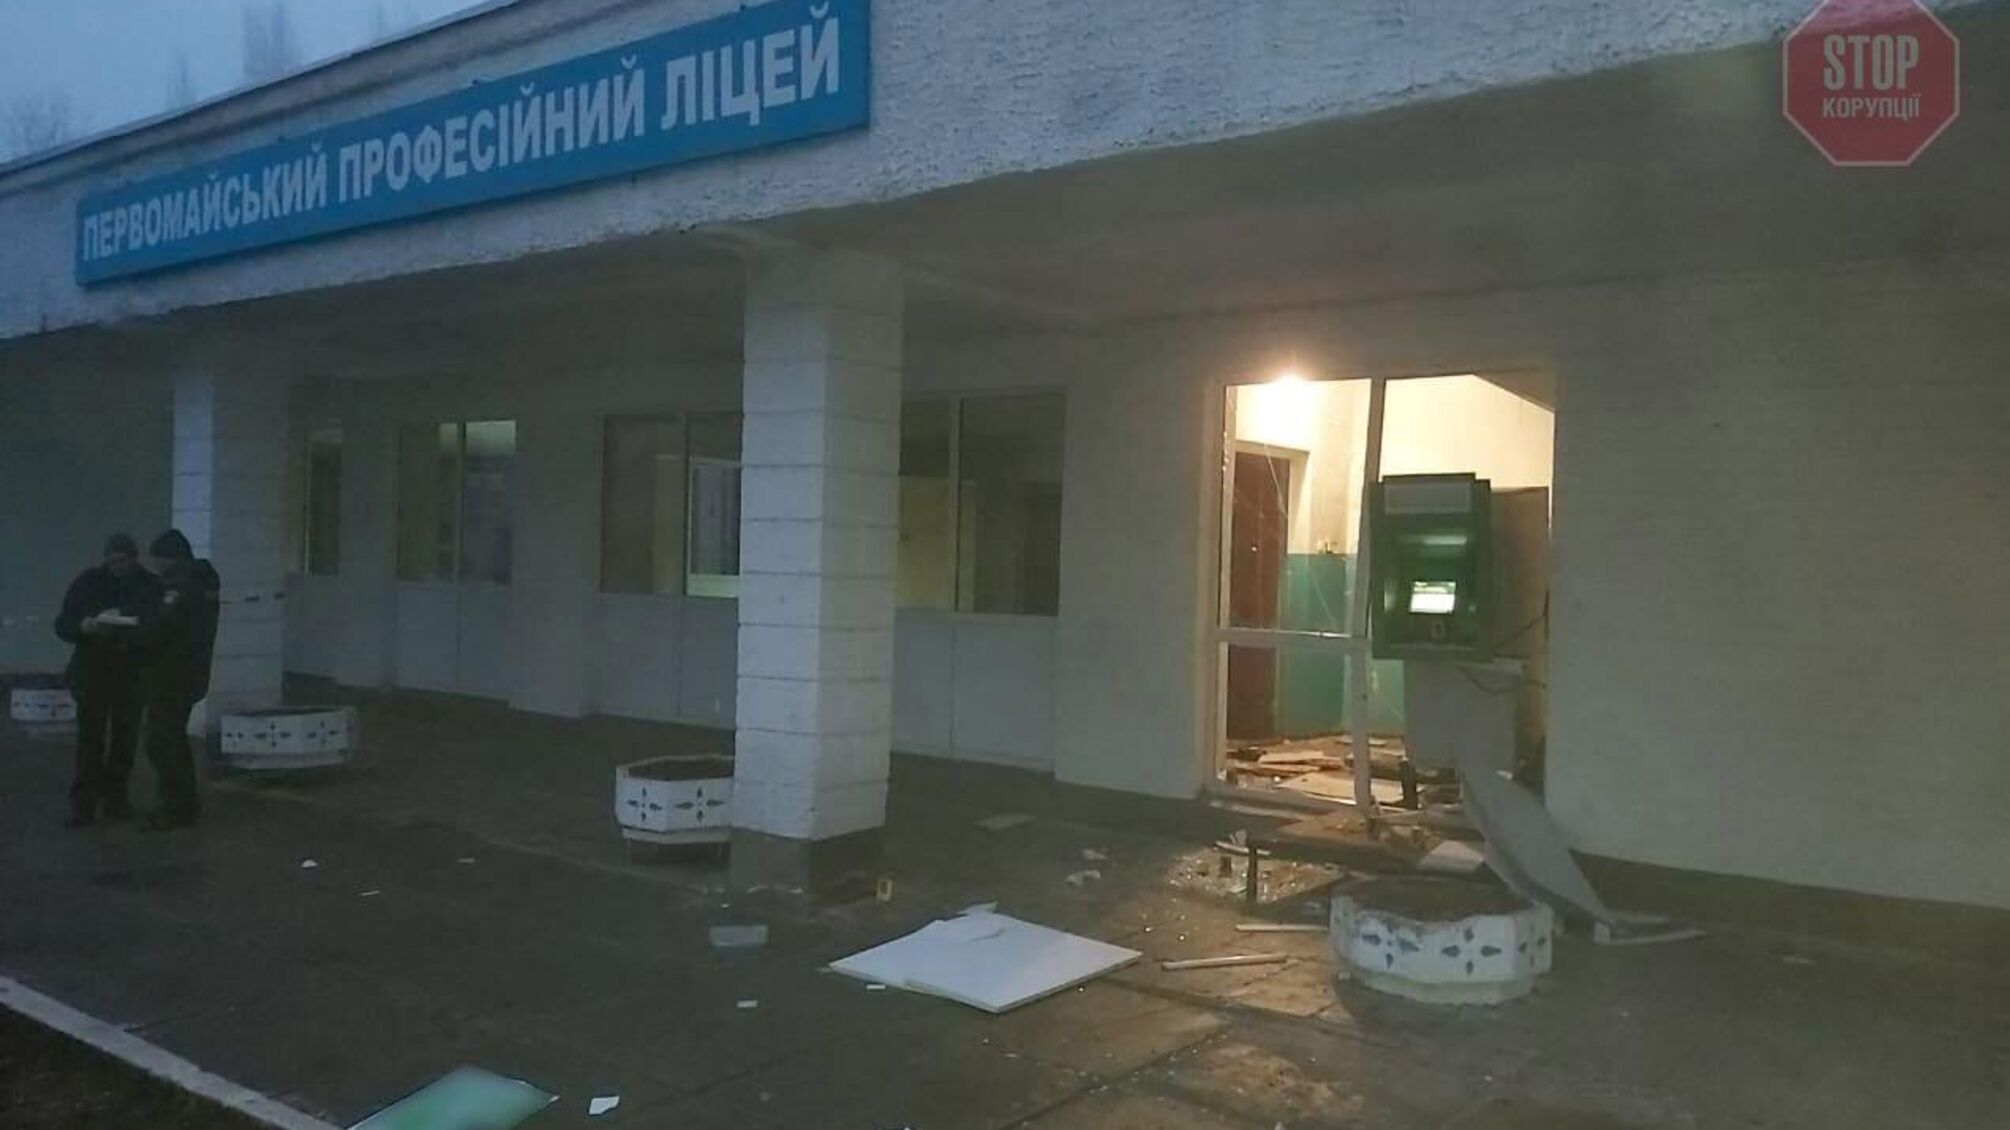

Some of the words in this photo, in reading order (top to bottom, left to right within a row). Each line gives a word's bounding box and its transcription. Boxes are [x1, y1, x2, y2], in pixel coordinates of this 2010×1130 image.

[83, 141, 328, 262] ПЕРВОМАЙСЬКИЙ
[339, 54, 645, 203] ПРОФЕСІЙНИЙ
[661, 1, 840, 131] ЛІЦЕЙ
